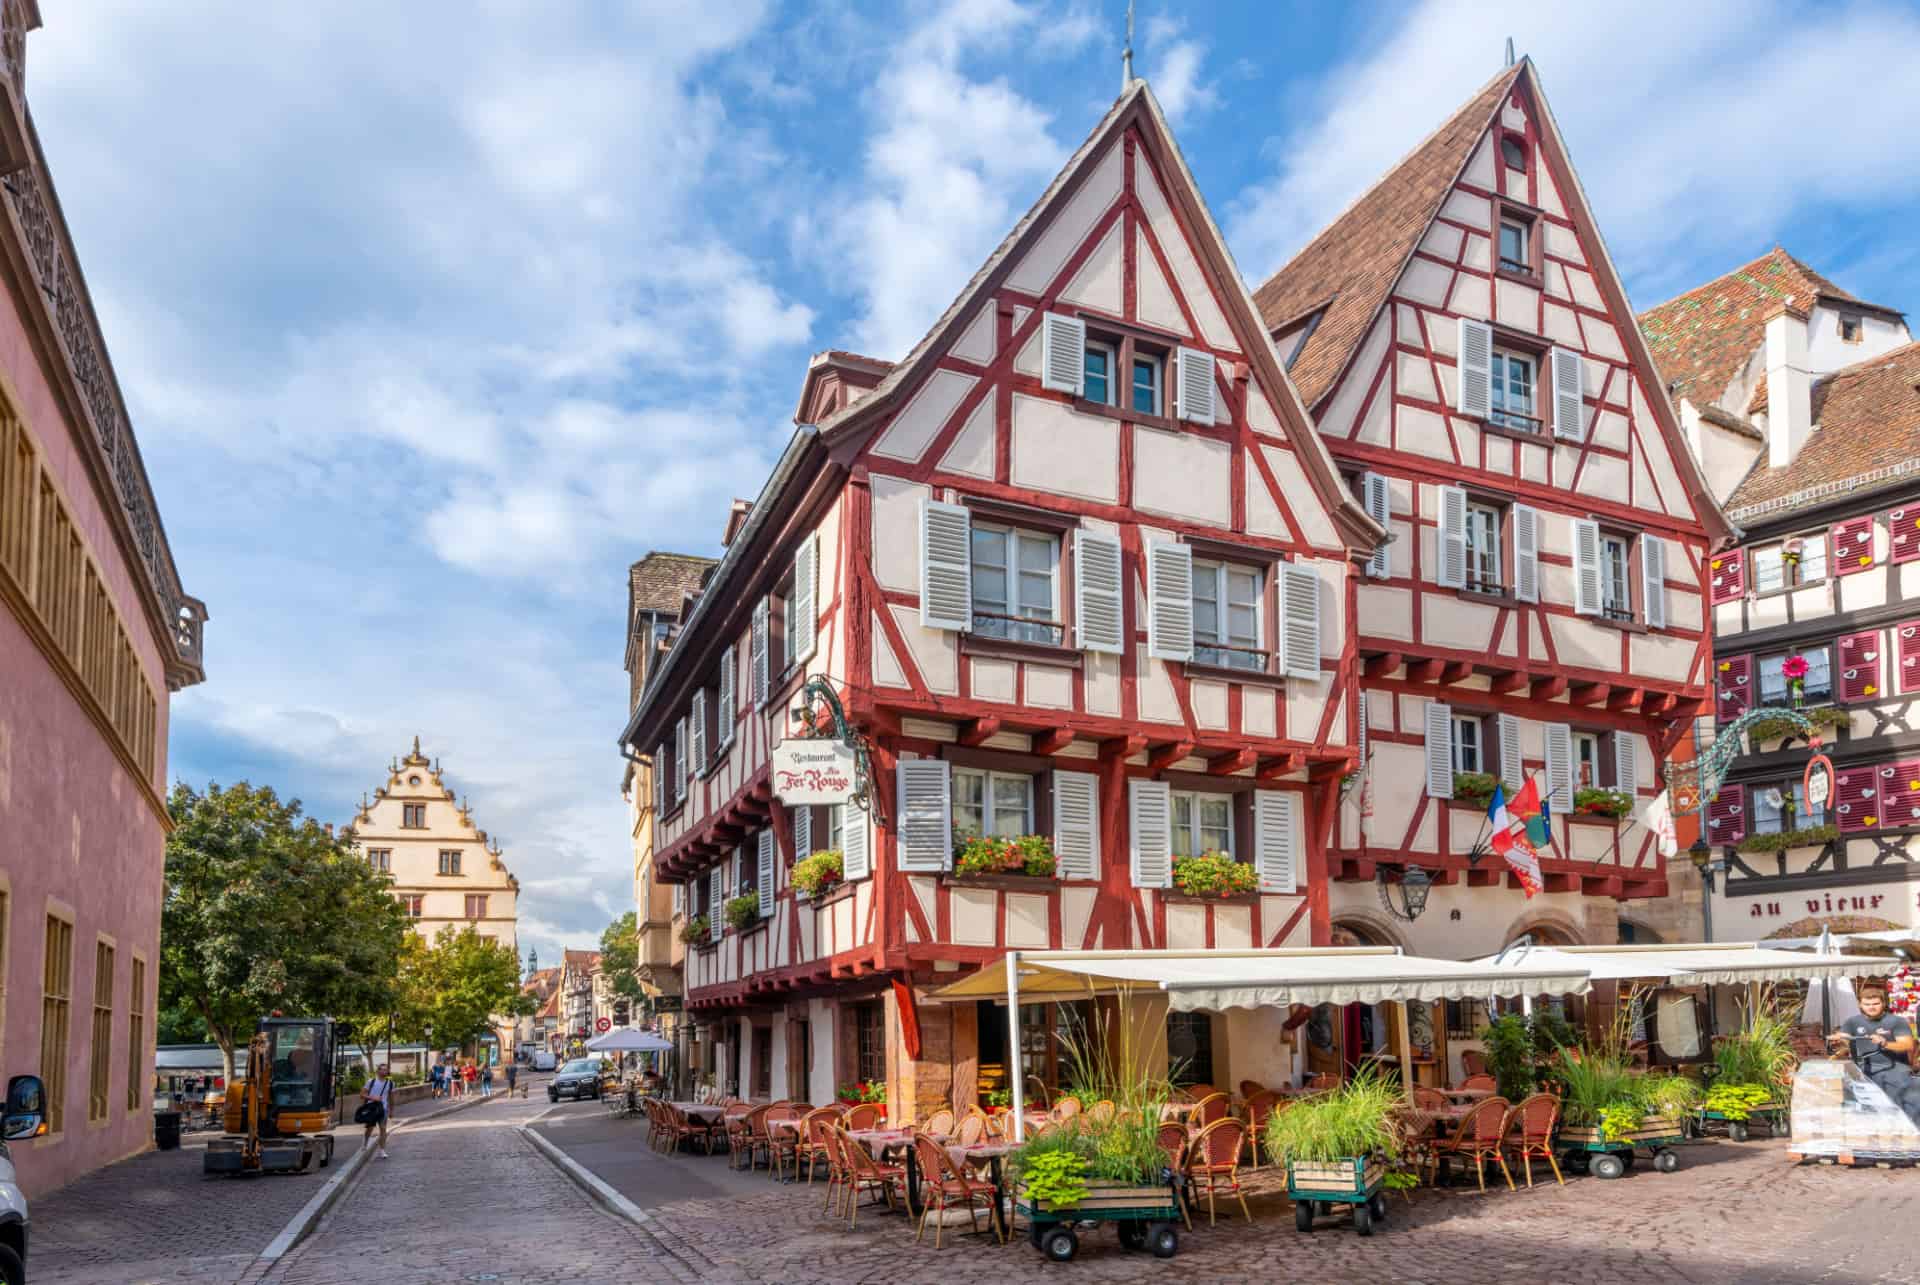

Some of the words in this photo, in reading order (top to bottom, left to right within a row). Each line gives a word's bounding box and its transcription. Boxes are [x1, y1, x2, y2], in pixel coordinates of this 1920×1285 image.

[790, 752, 836, 764] Restaurant
[776, 770, 804, 792] Fer
[804, 769, 849, 792] Rouge
[1751, 902, 1781, 916] au
[1806, 893, 1884, 913] vieux
